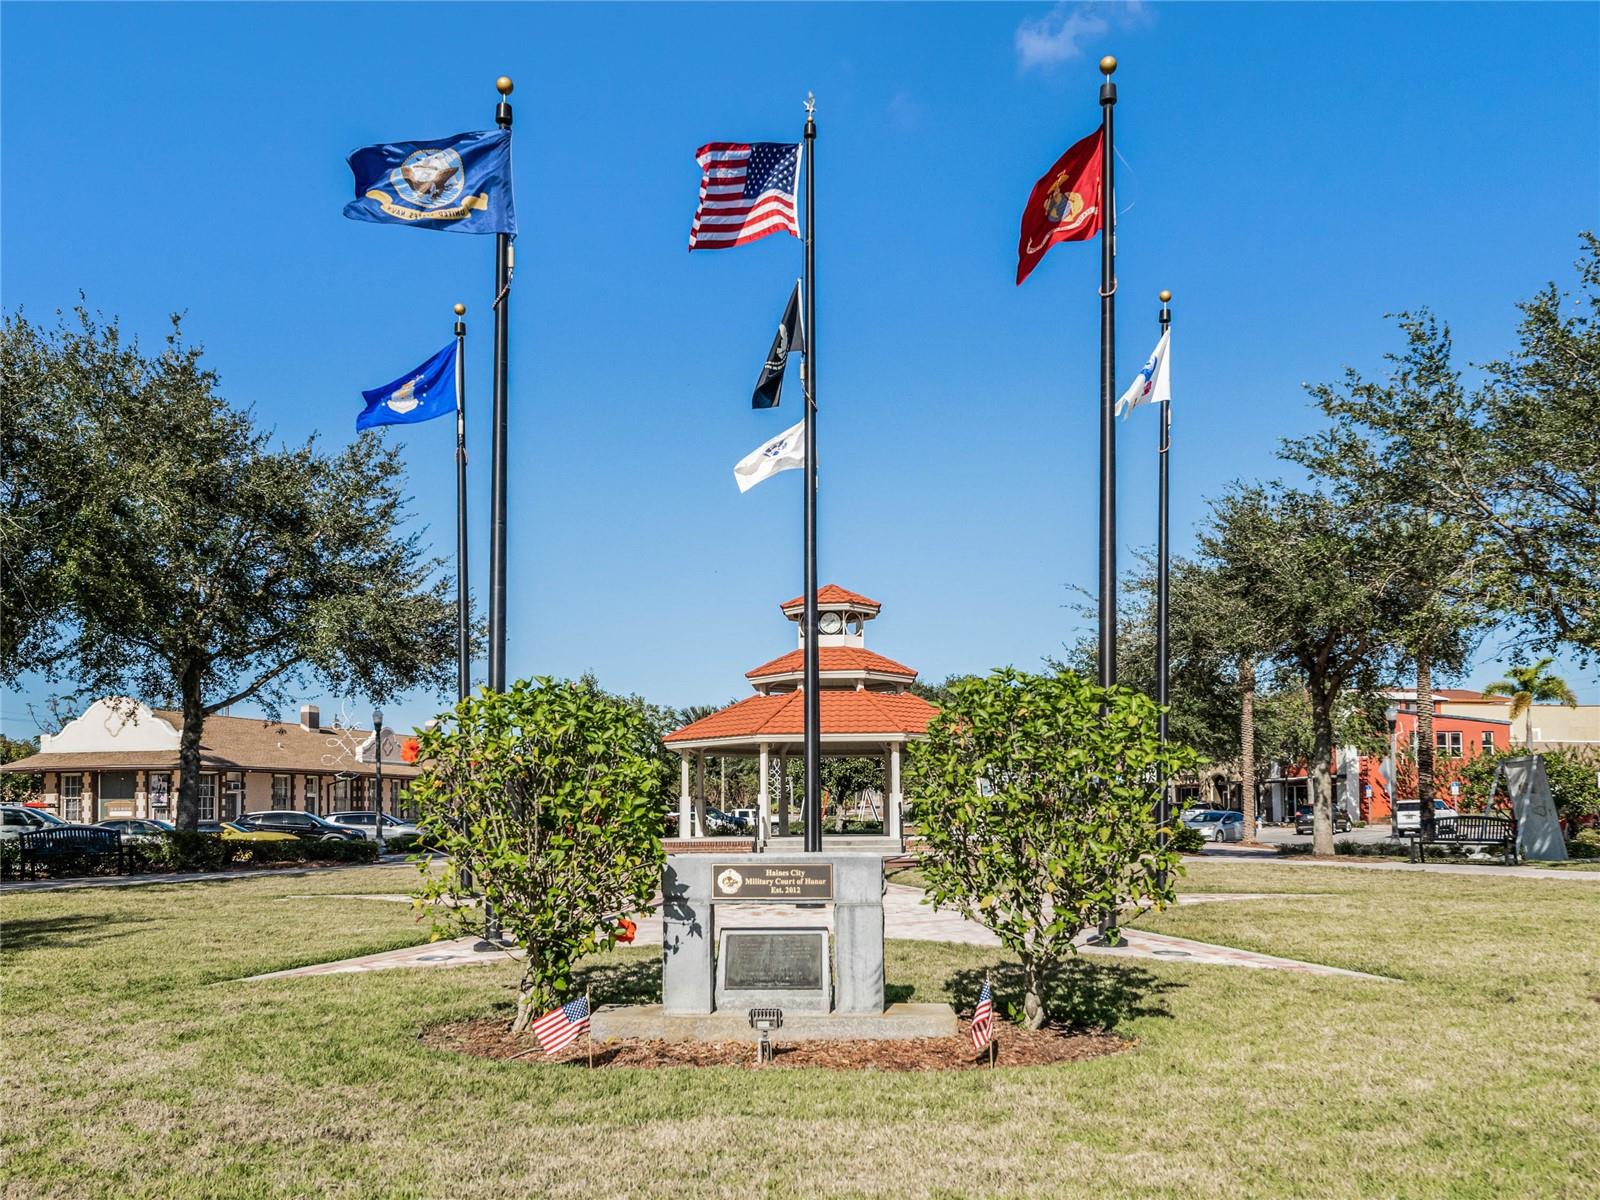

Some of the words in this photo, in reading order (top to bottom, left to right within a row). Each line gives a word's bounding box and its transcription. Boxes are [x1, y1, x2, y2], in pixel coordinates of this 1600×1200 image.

[766, 869, 789, 877] Haines
[790, 869, 805, 878] City
[745, 878, 774, 886] Military
[770, 886, 784, 894] Est.
[785, 886, 801, 894] 2012
